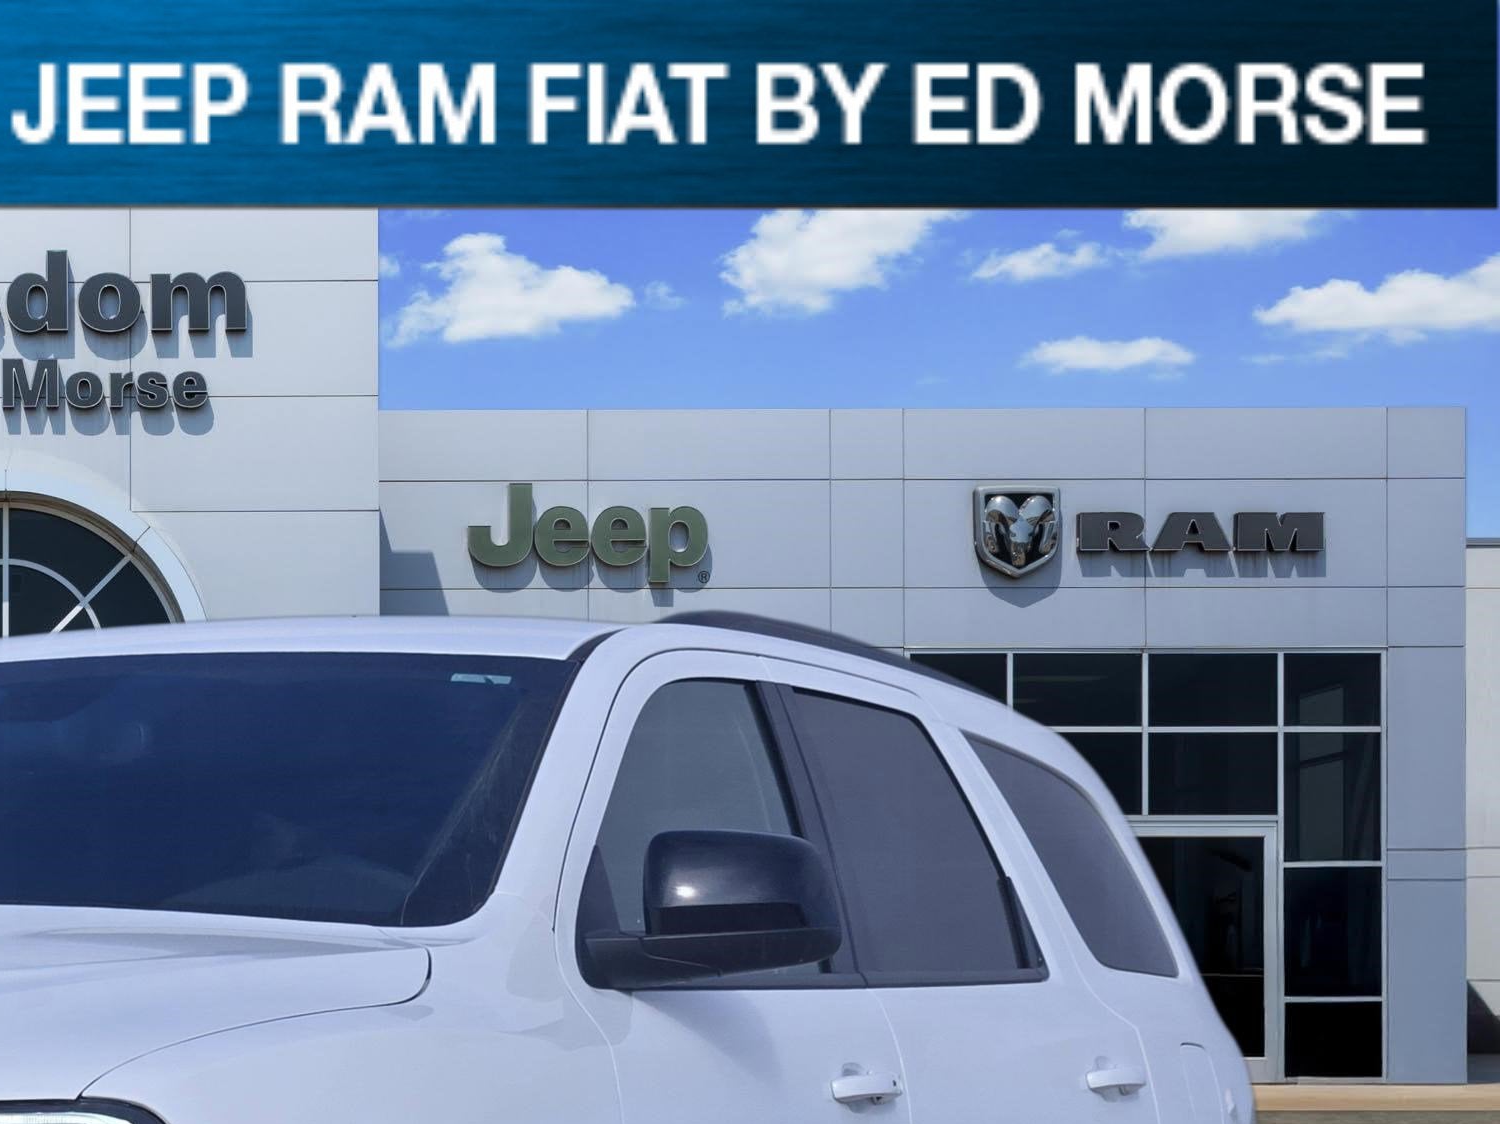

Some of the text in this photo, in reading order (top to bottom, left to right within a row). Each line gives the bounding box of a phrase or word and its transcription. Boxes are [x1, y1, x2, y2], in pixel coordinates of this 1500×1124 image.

[1, 358, 209, 409] Morse
[466, 482, 709, 584] Jeep
[1075, 511, 1326, 553] RAM
